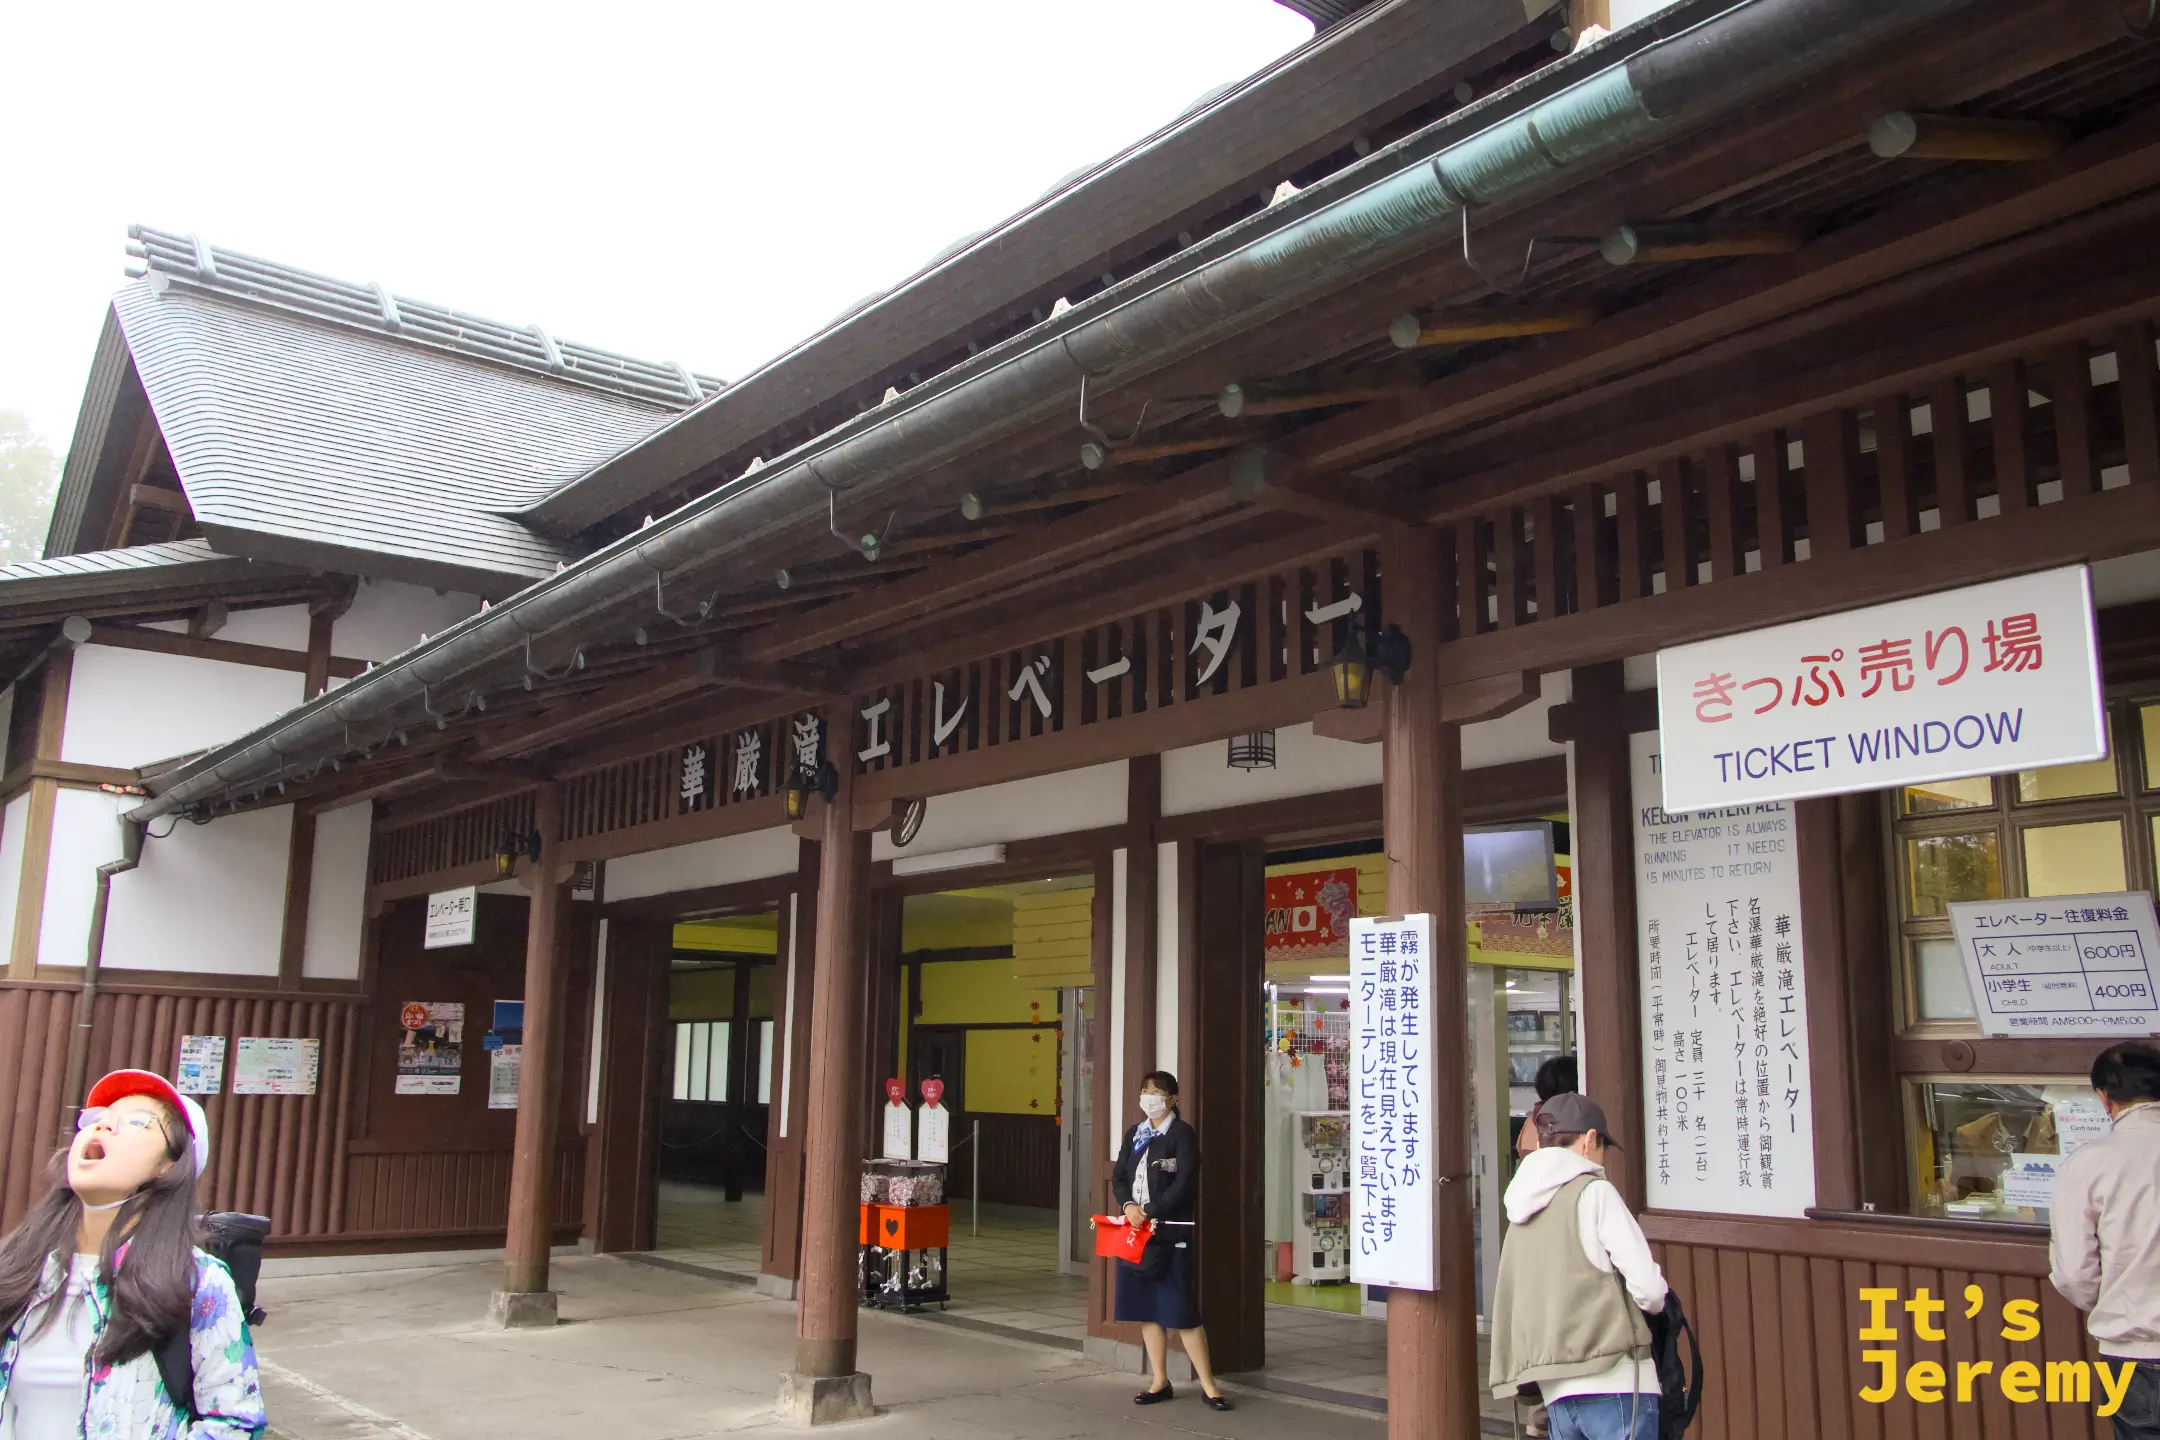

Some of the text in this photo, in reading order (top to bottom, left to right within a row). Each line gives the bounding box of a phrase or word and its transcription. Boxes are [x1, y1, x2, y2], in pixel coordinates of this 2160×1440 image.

[1692, 612, 2043, 723] きっぷ売り場
[1714, 707, 2023, 782] TICKET WINDOW
[1649, 819, 1787, 844] THE ELEVATOR IS ALWAYS
[1644, 839, 1786, 864] RUNNING IT NEEDS
[1646, 861, 1772, 884] 15 MINUTES TO RETURN
[1974, 906, 2130, 928] エレベーター往復料金
[2084, 944, 2136, 960] 600円
[1990, 962, 2019, 971] ADULT
[1988, 978, 2033, 993] 小学生
[2095, 983, 2147, 998] 400円
[2001, 998, 2028, 1007] CHILD
[1774, 914, 1799, 1133] 華厳滝エレベーター
[2009, 1017, 2048, 1026] 営業時間
[1400, 930, 1420, 1187] 霧が発生していますが
[1360, 933, 1378, 1256] モニターテレビをご覧下さい
[1379, 932, 1397, 1243] 華厳滝は現在見えています
